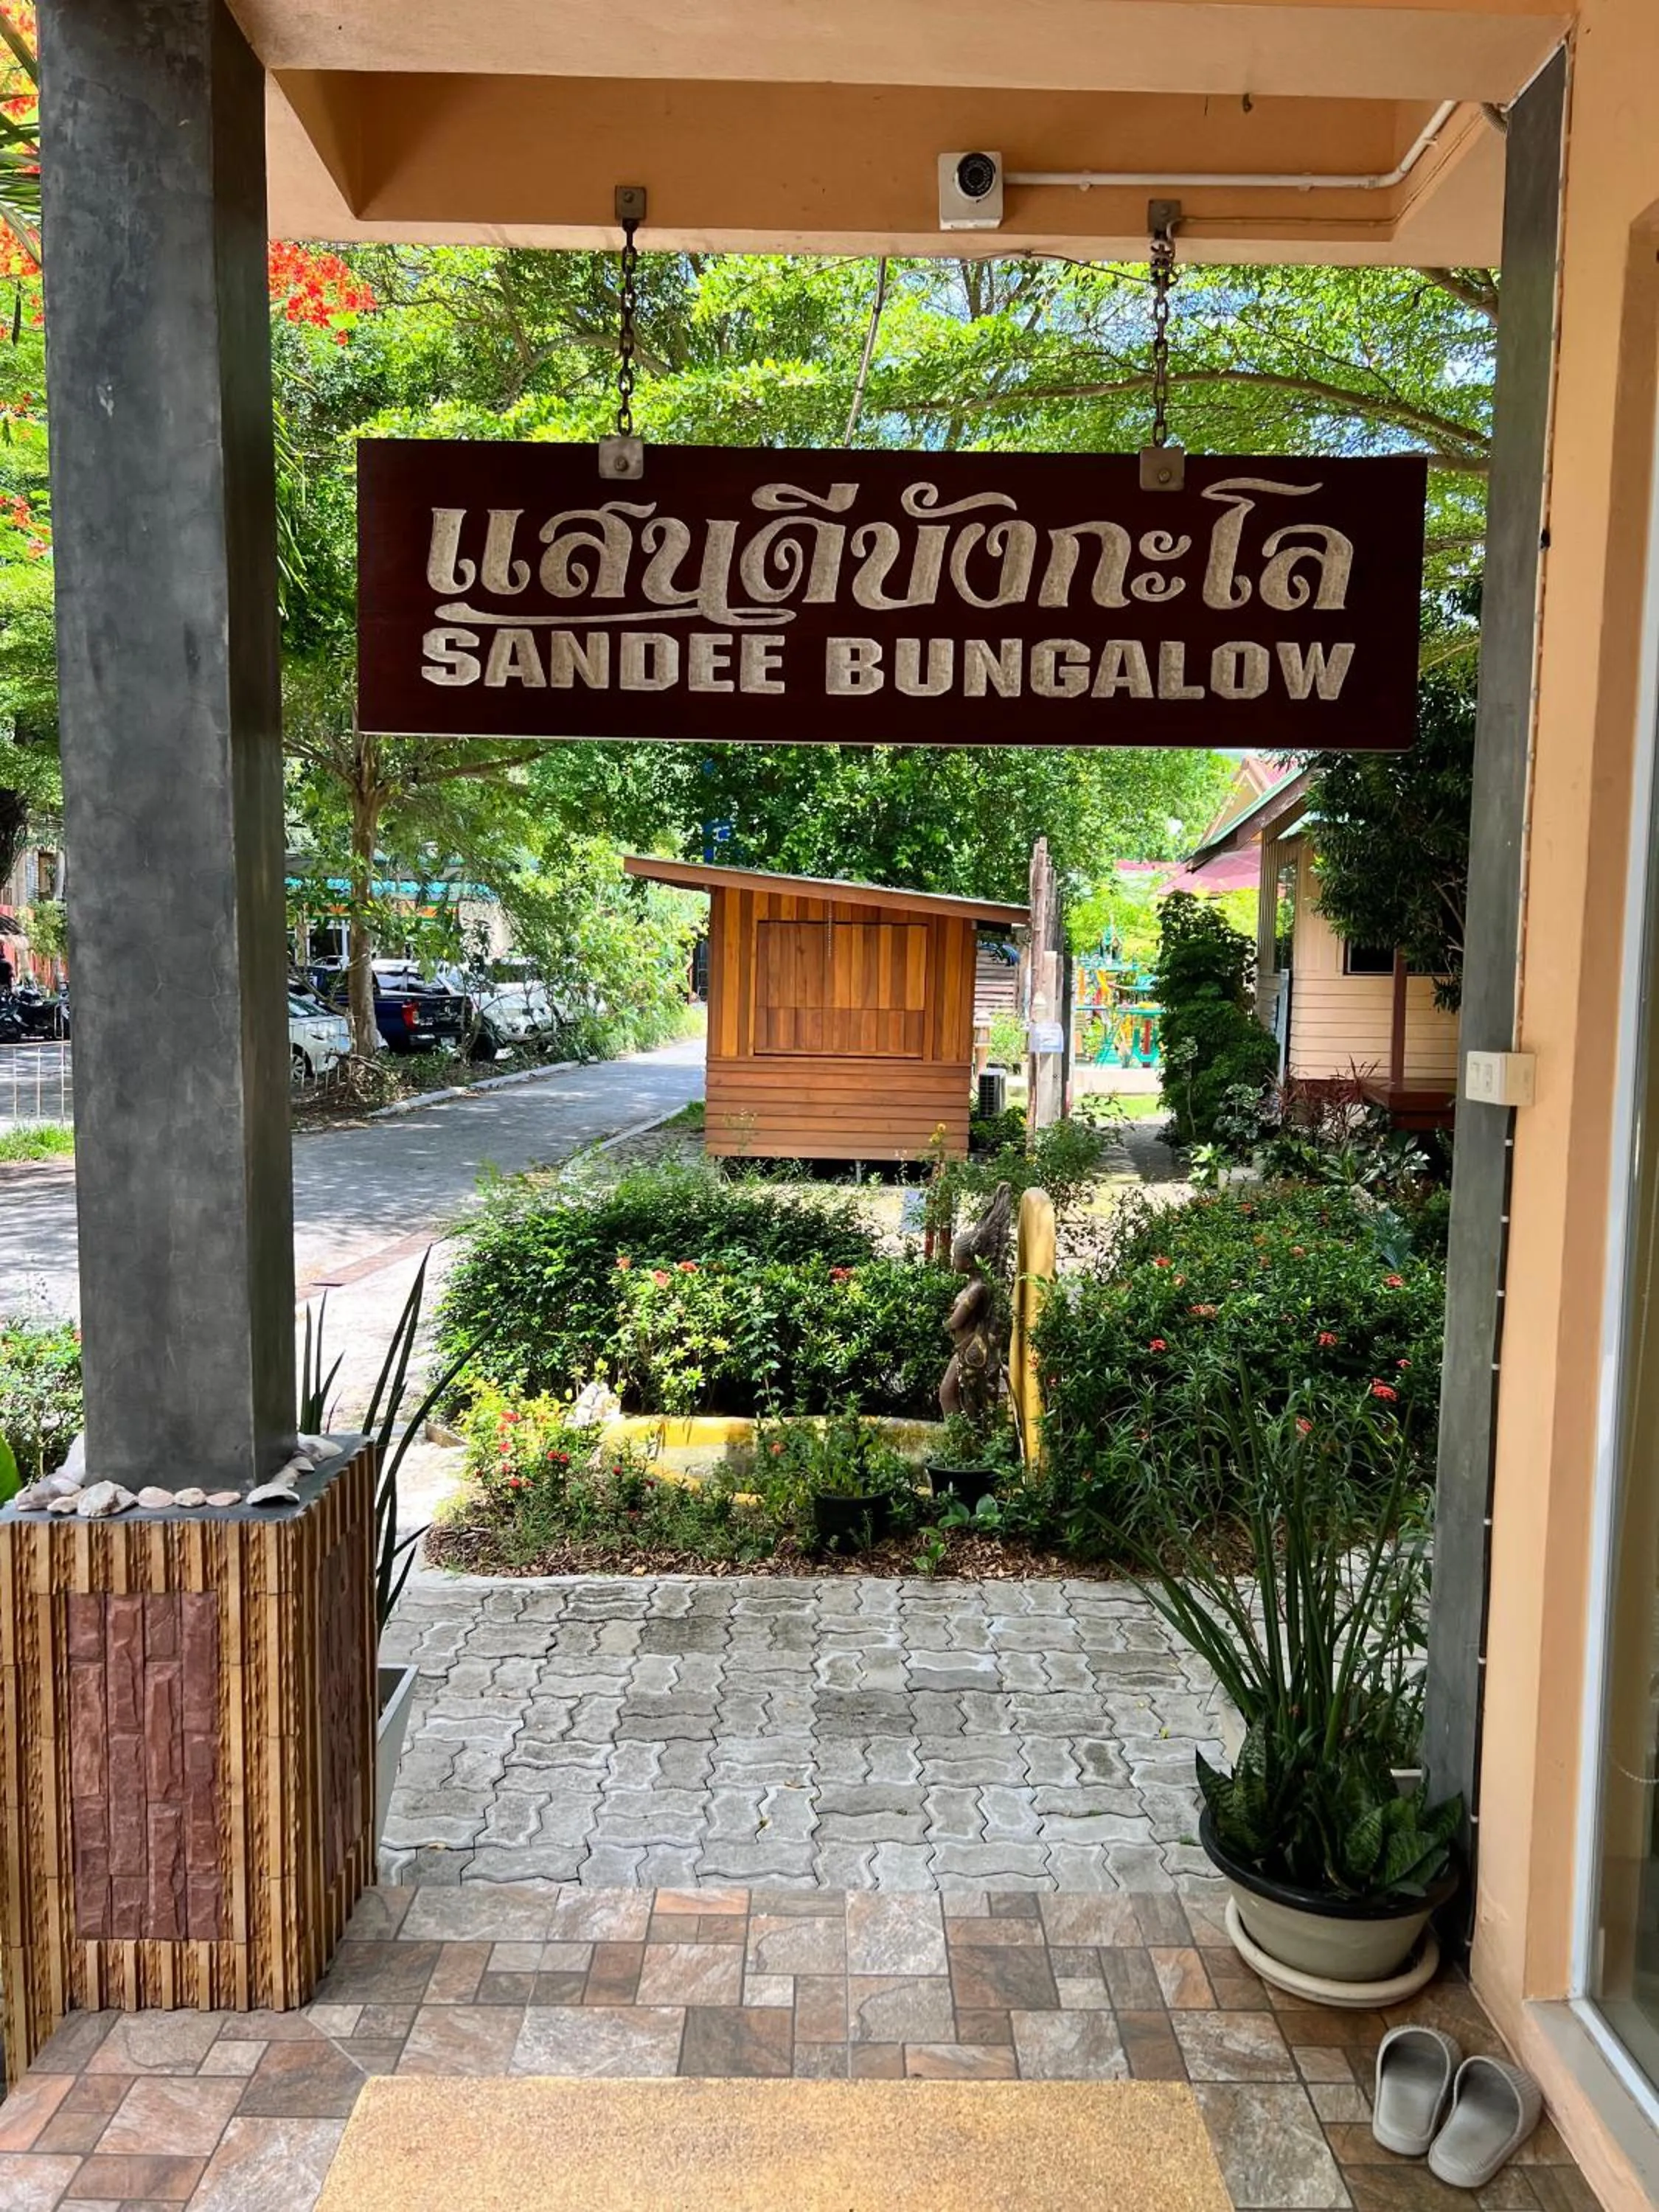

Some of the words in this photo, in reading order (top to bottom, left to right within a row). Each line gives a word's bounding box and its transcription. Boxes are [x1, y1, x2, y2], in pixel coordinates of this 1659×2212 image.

[426, 477, 1354, 626] แสนดีบังกะโล
[421, 627, 786, 695] SANDEE
[825, 636, 1356, 700] BUNGALOW
